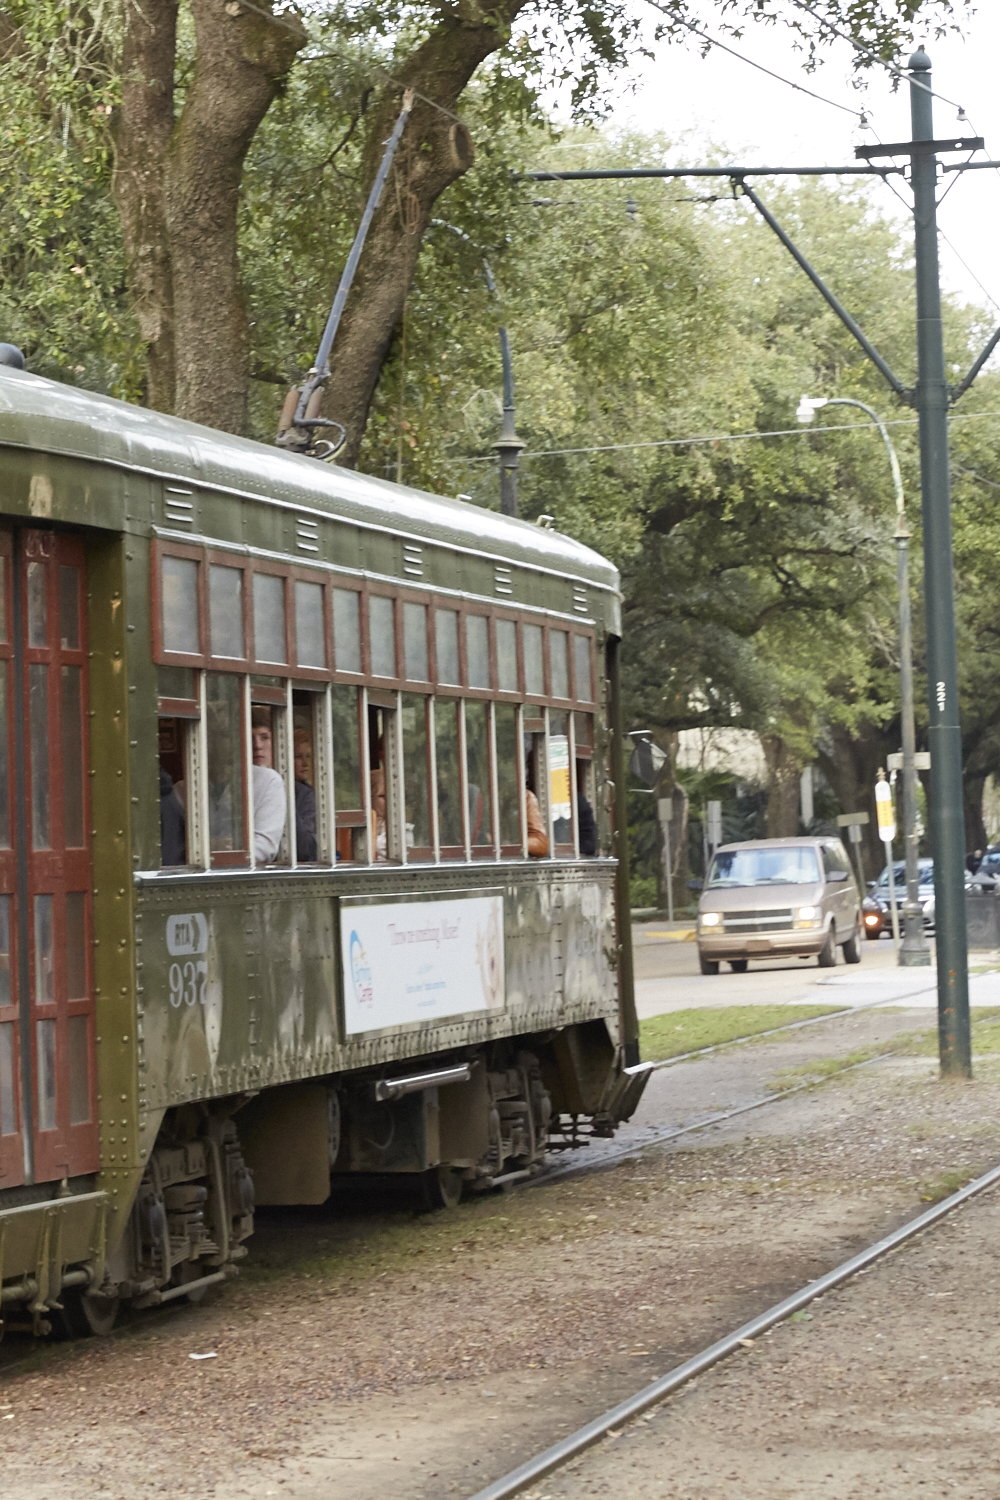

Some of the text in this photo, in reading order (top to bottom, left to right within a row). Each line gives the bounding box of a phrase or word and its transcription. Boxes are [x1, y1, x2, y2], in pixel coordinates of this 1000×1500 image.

[936, 681, 946, 712] 221
[175, 923, 191, 946] RTA
[169, 960, 208, 1008] 937
